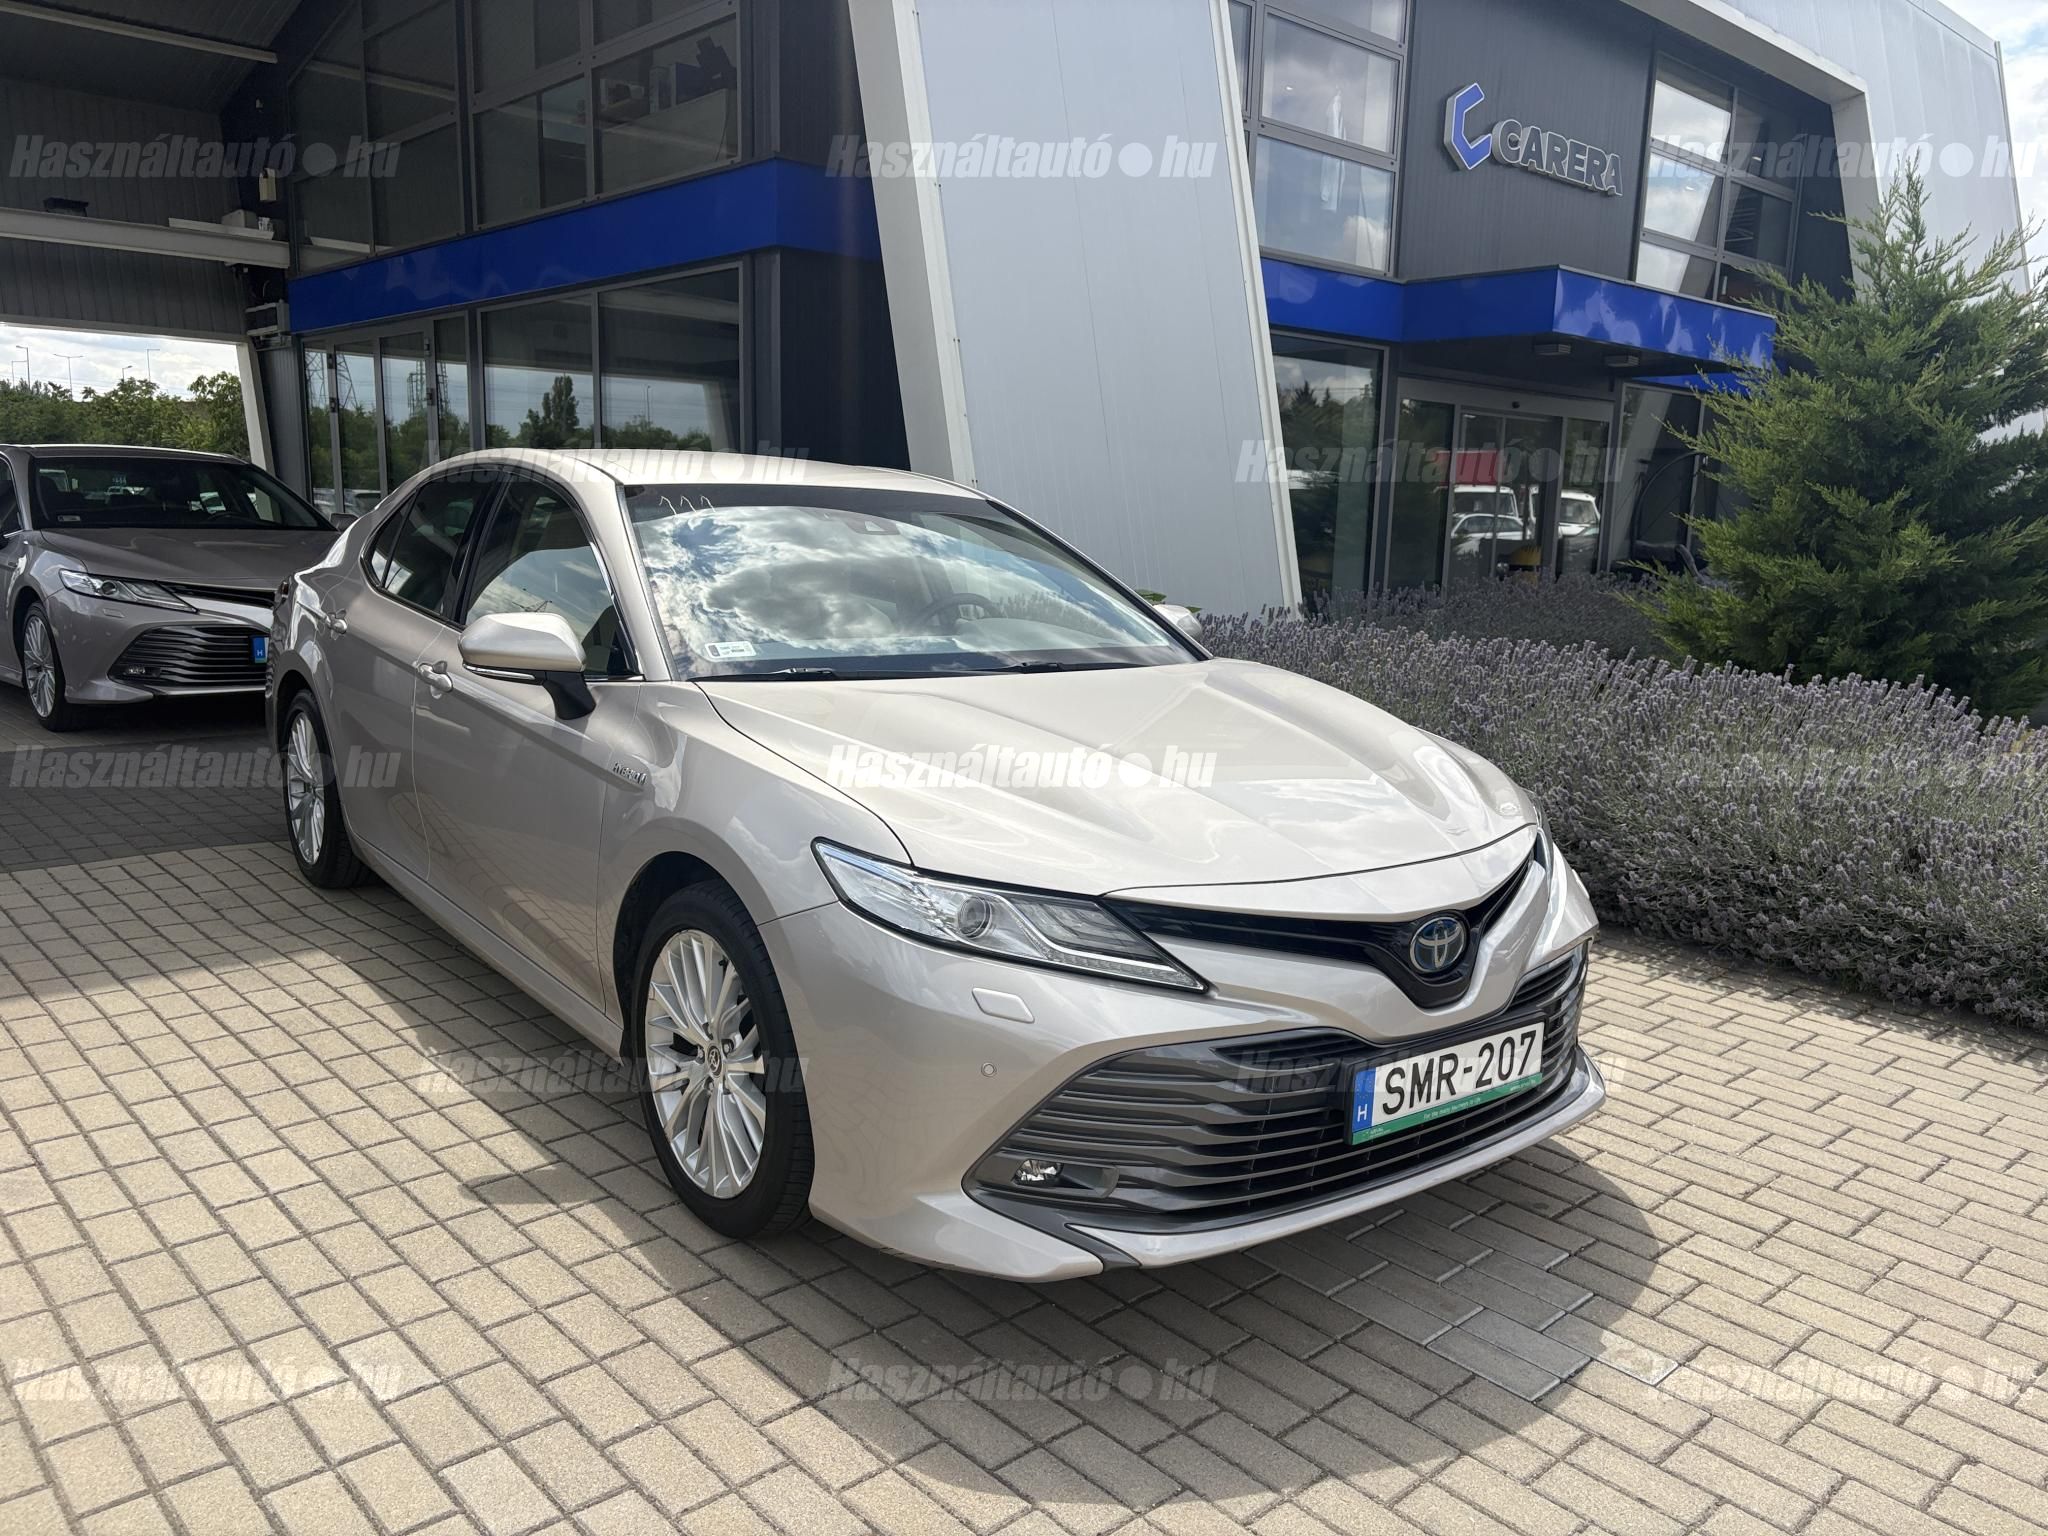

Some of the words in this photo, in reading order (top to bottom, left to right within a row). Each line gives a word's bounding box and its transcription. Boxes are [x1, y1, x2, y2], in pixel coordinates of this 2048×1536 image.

[1494, 118, 1623, 196] CARERA
[1382, 1030, 1537, 1115] SMR-207
[1356, 1103, 1369, 1123] H
